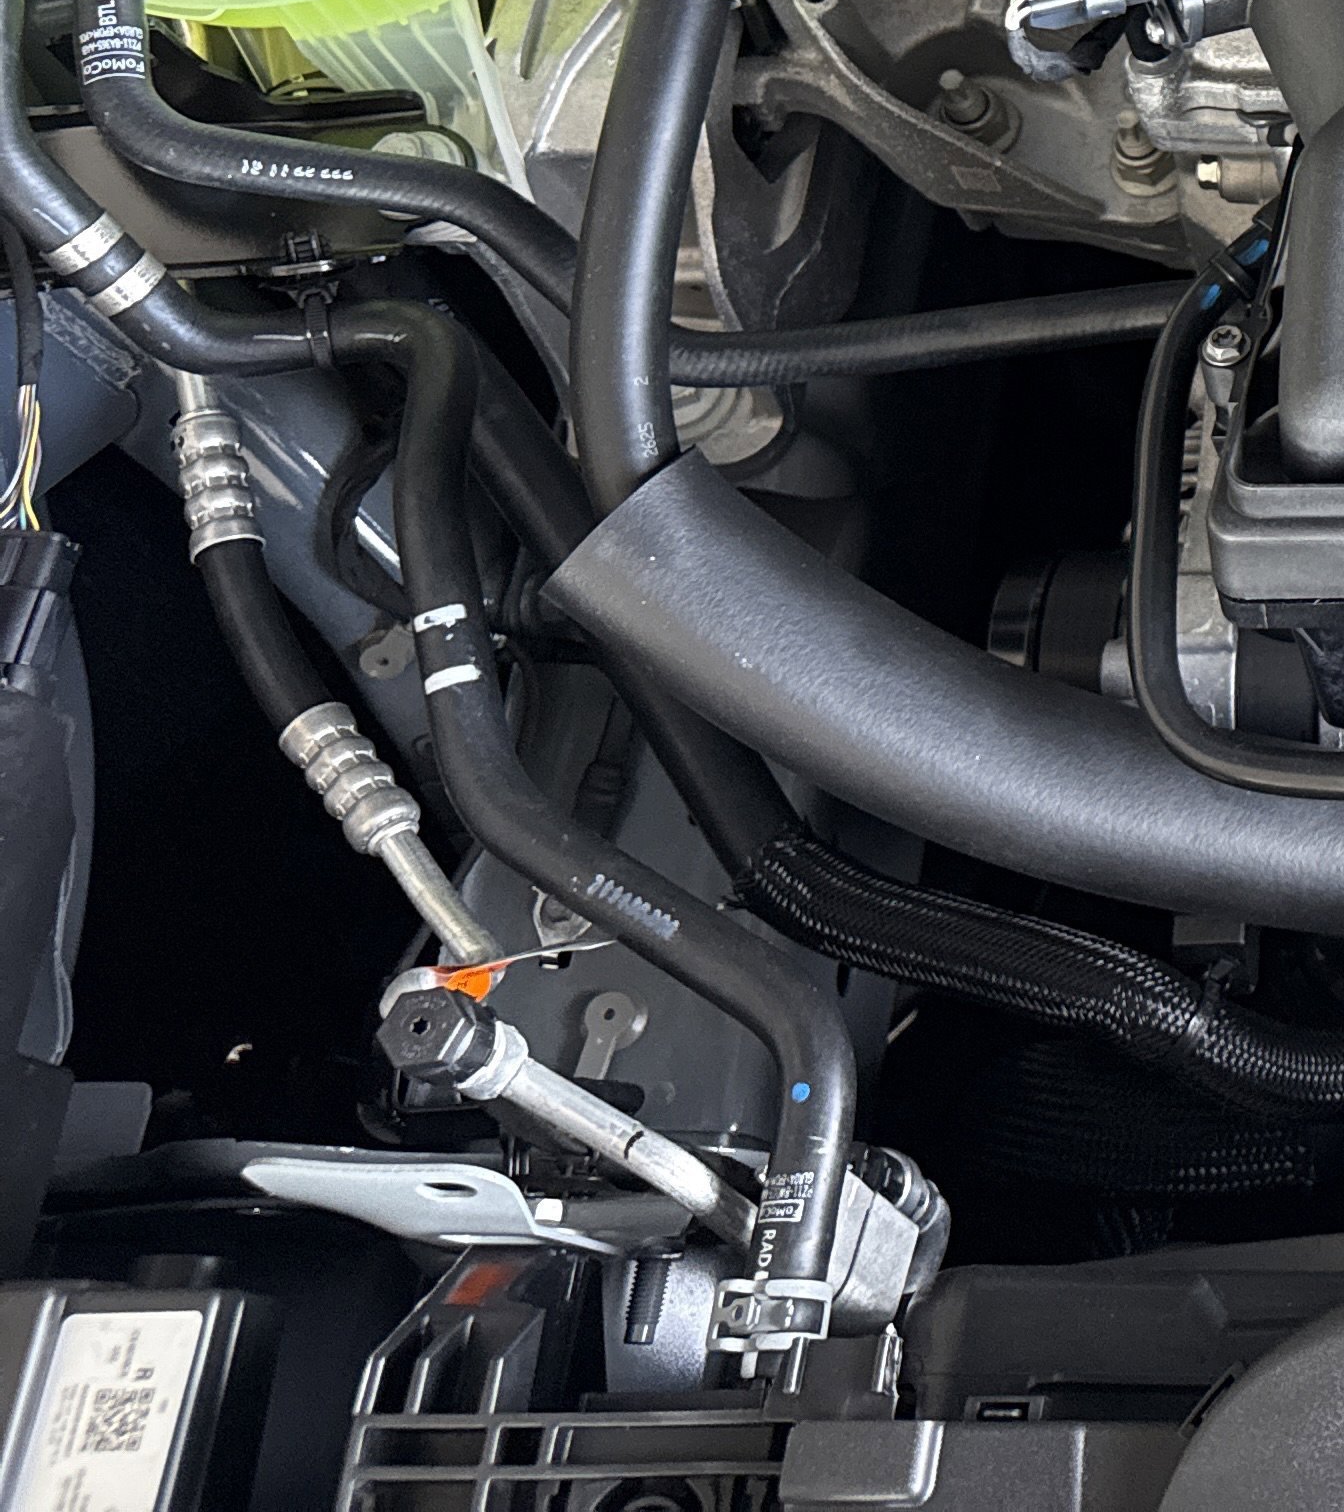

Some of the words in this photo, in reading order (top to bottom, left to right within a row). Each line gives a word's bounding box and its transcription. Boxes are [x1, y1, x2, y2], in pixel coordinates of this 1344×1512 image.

[97, 0, 118, 26] BTL
[82, 56, 146, 76] FoMoCo
[637, 421, 660, 459] 2625
[756, 1228, 778, 1269] RAD
